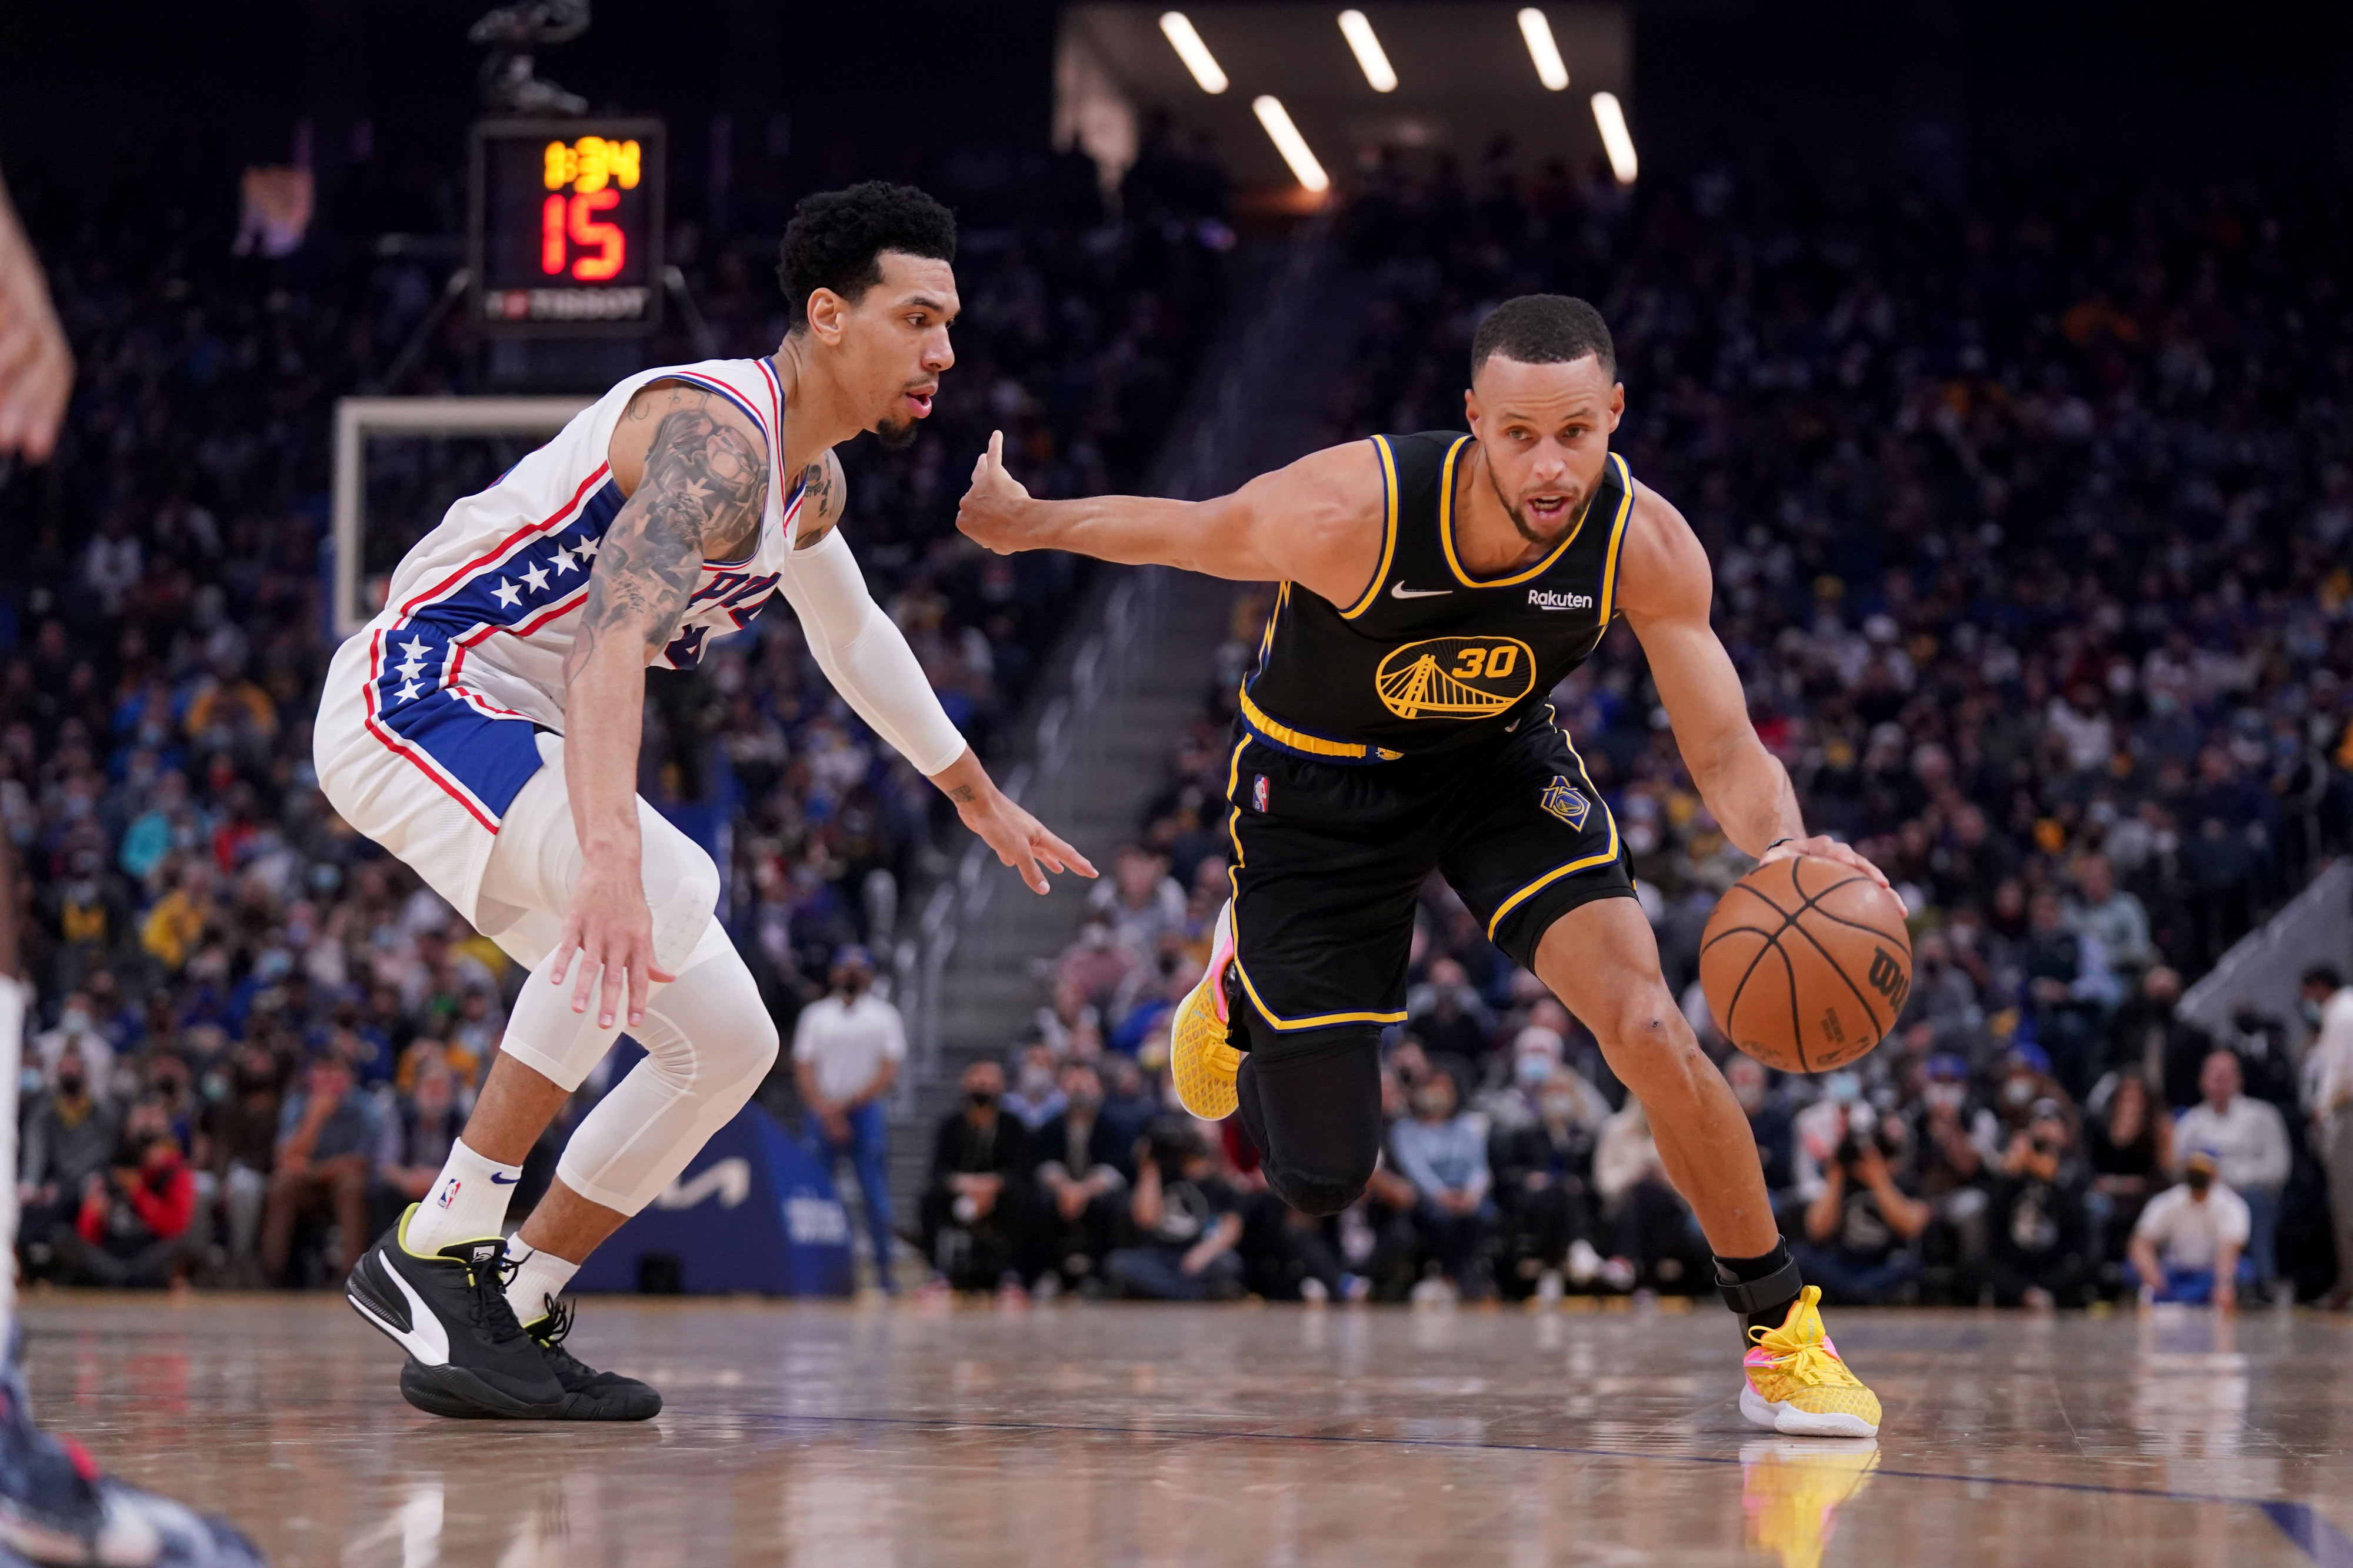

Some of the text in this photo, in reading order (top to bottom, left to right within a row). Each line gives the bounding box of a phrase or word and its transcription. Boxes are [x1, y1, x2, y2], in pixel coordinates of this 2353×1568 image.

[542, 189, 625, 281] 15
[1528, 589, 1592, 608] Rakuten
[1451, 645, 1519, 678] 30
